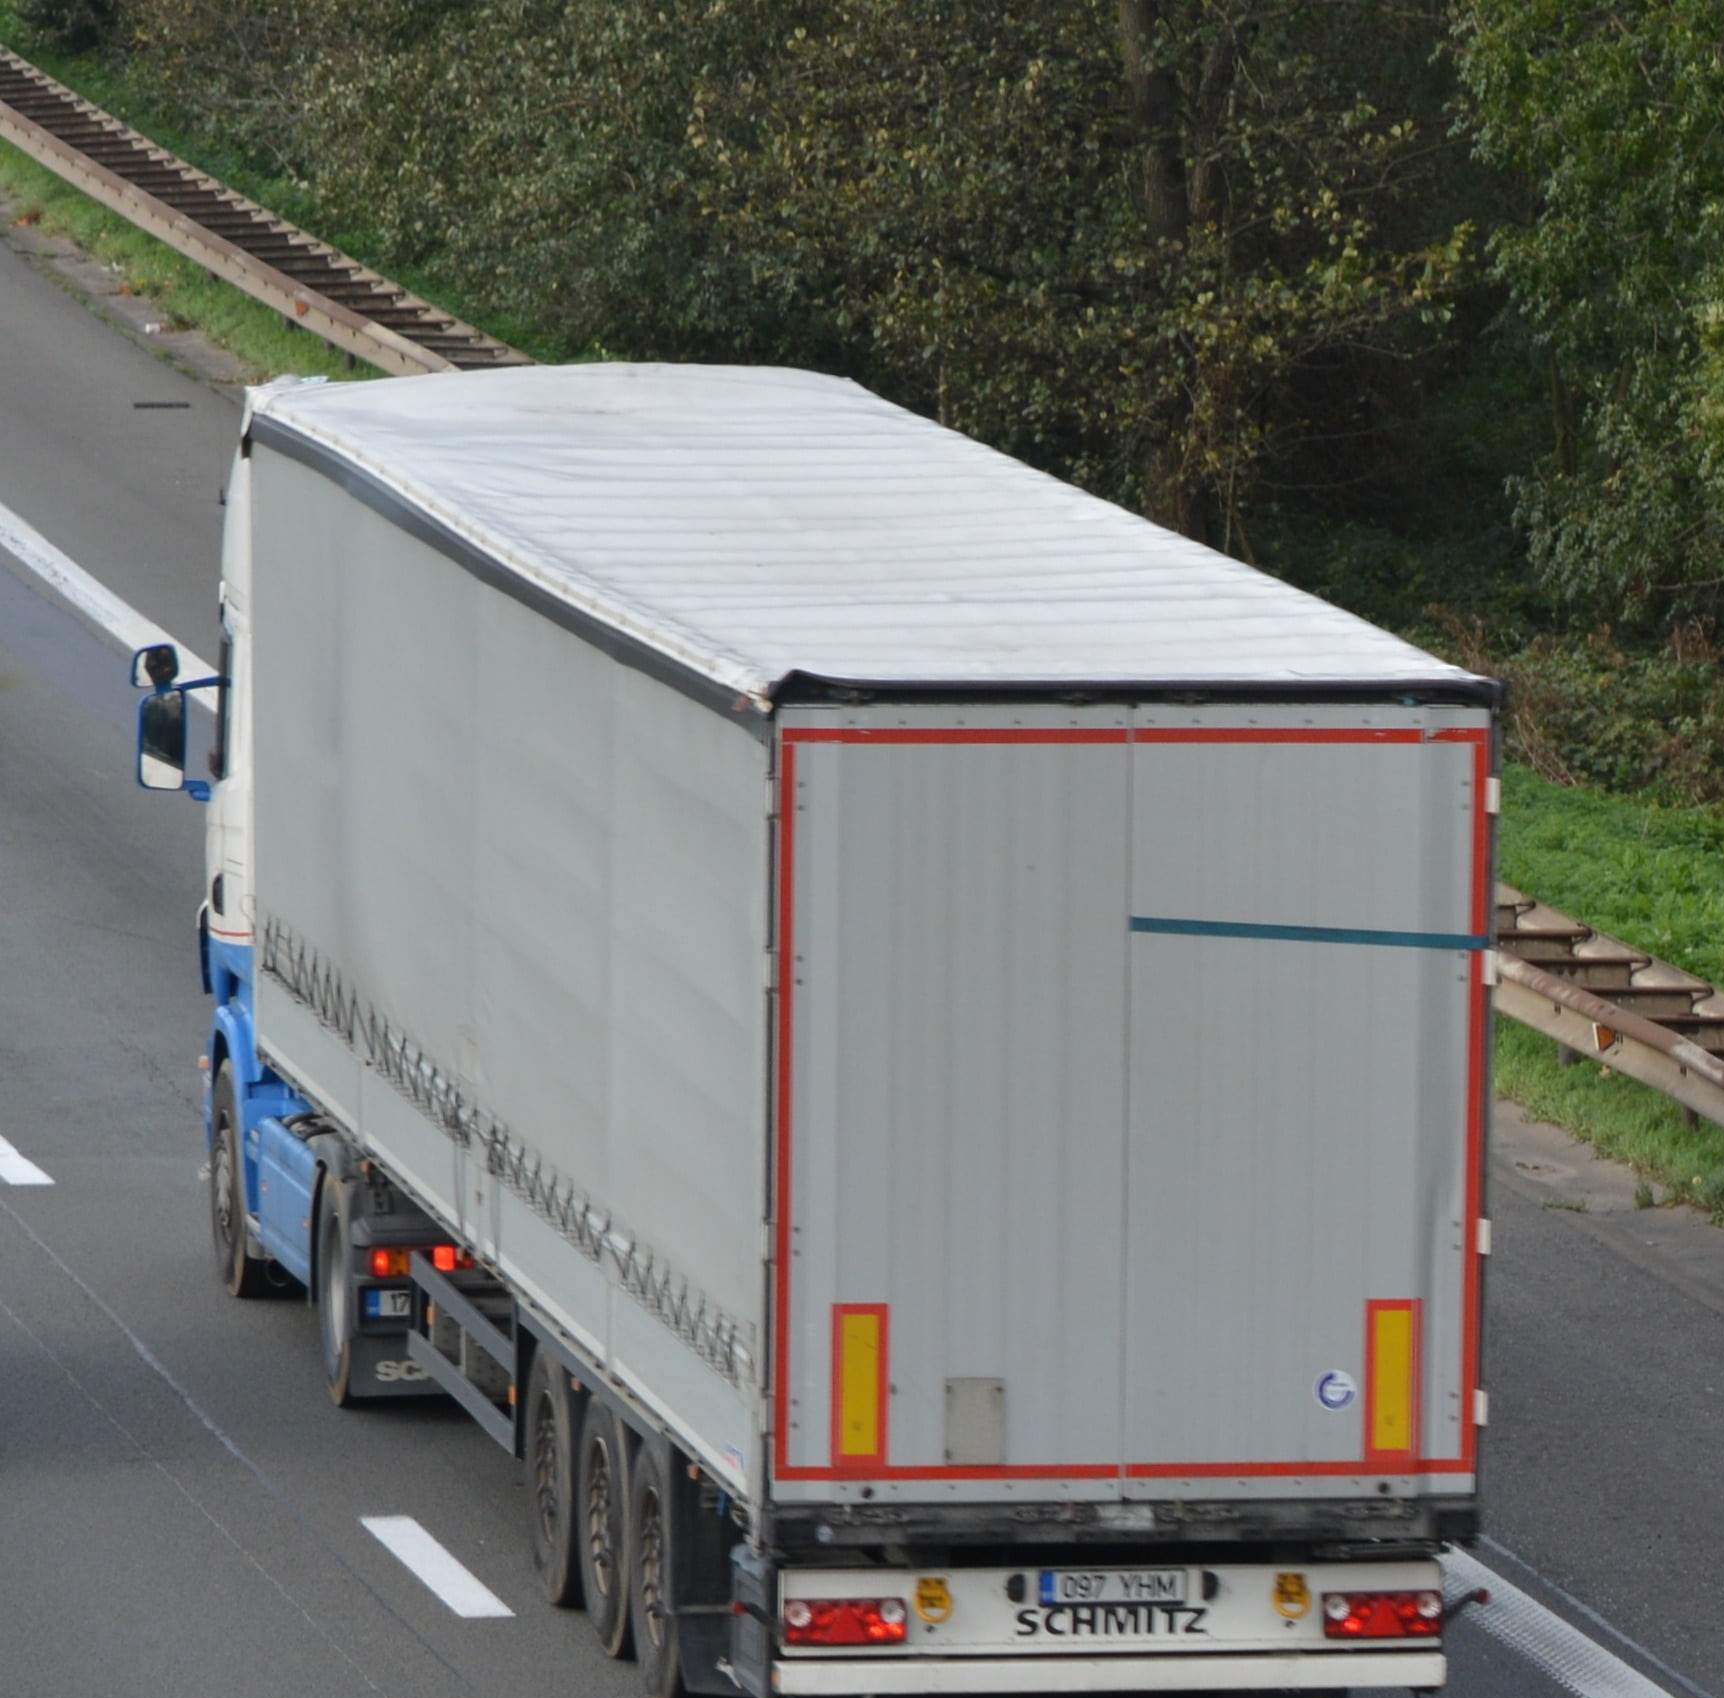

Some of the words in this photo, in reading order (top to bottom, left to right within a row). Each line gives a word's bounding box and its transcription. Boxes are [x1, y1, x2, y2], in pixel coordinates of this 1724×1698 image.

[1060, 1574, 1107, 1599] 097
[1119, 1573, 1177, 1599] YHM
[1015, 1605, 1208, 1636] SCHMITZ
